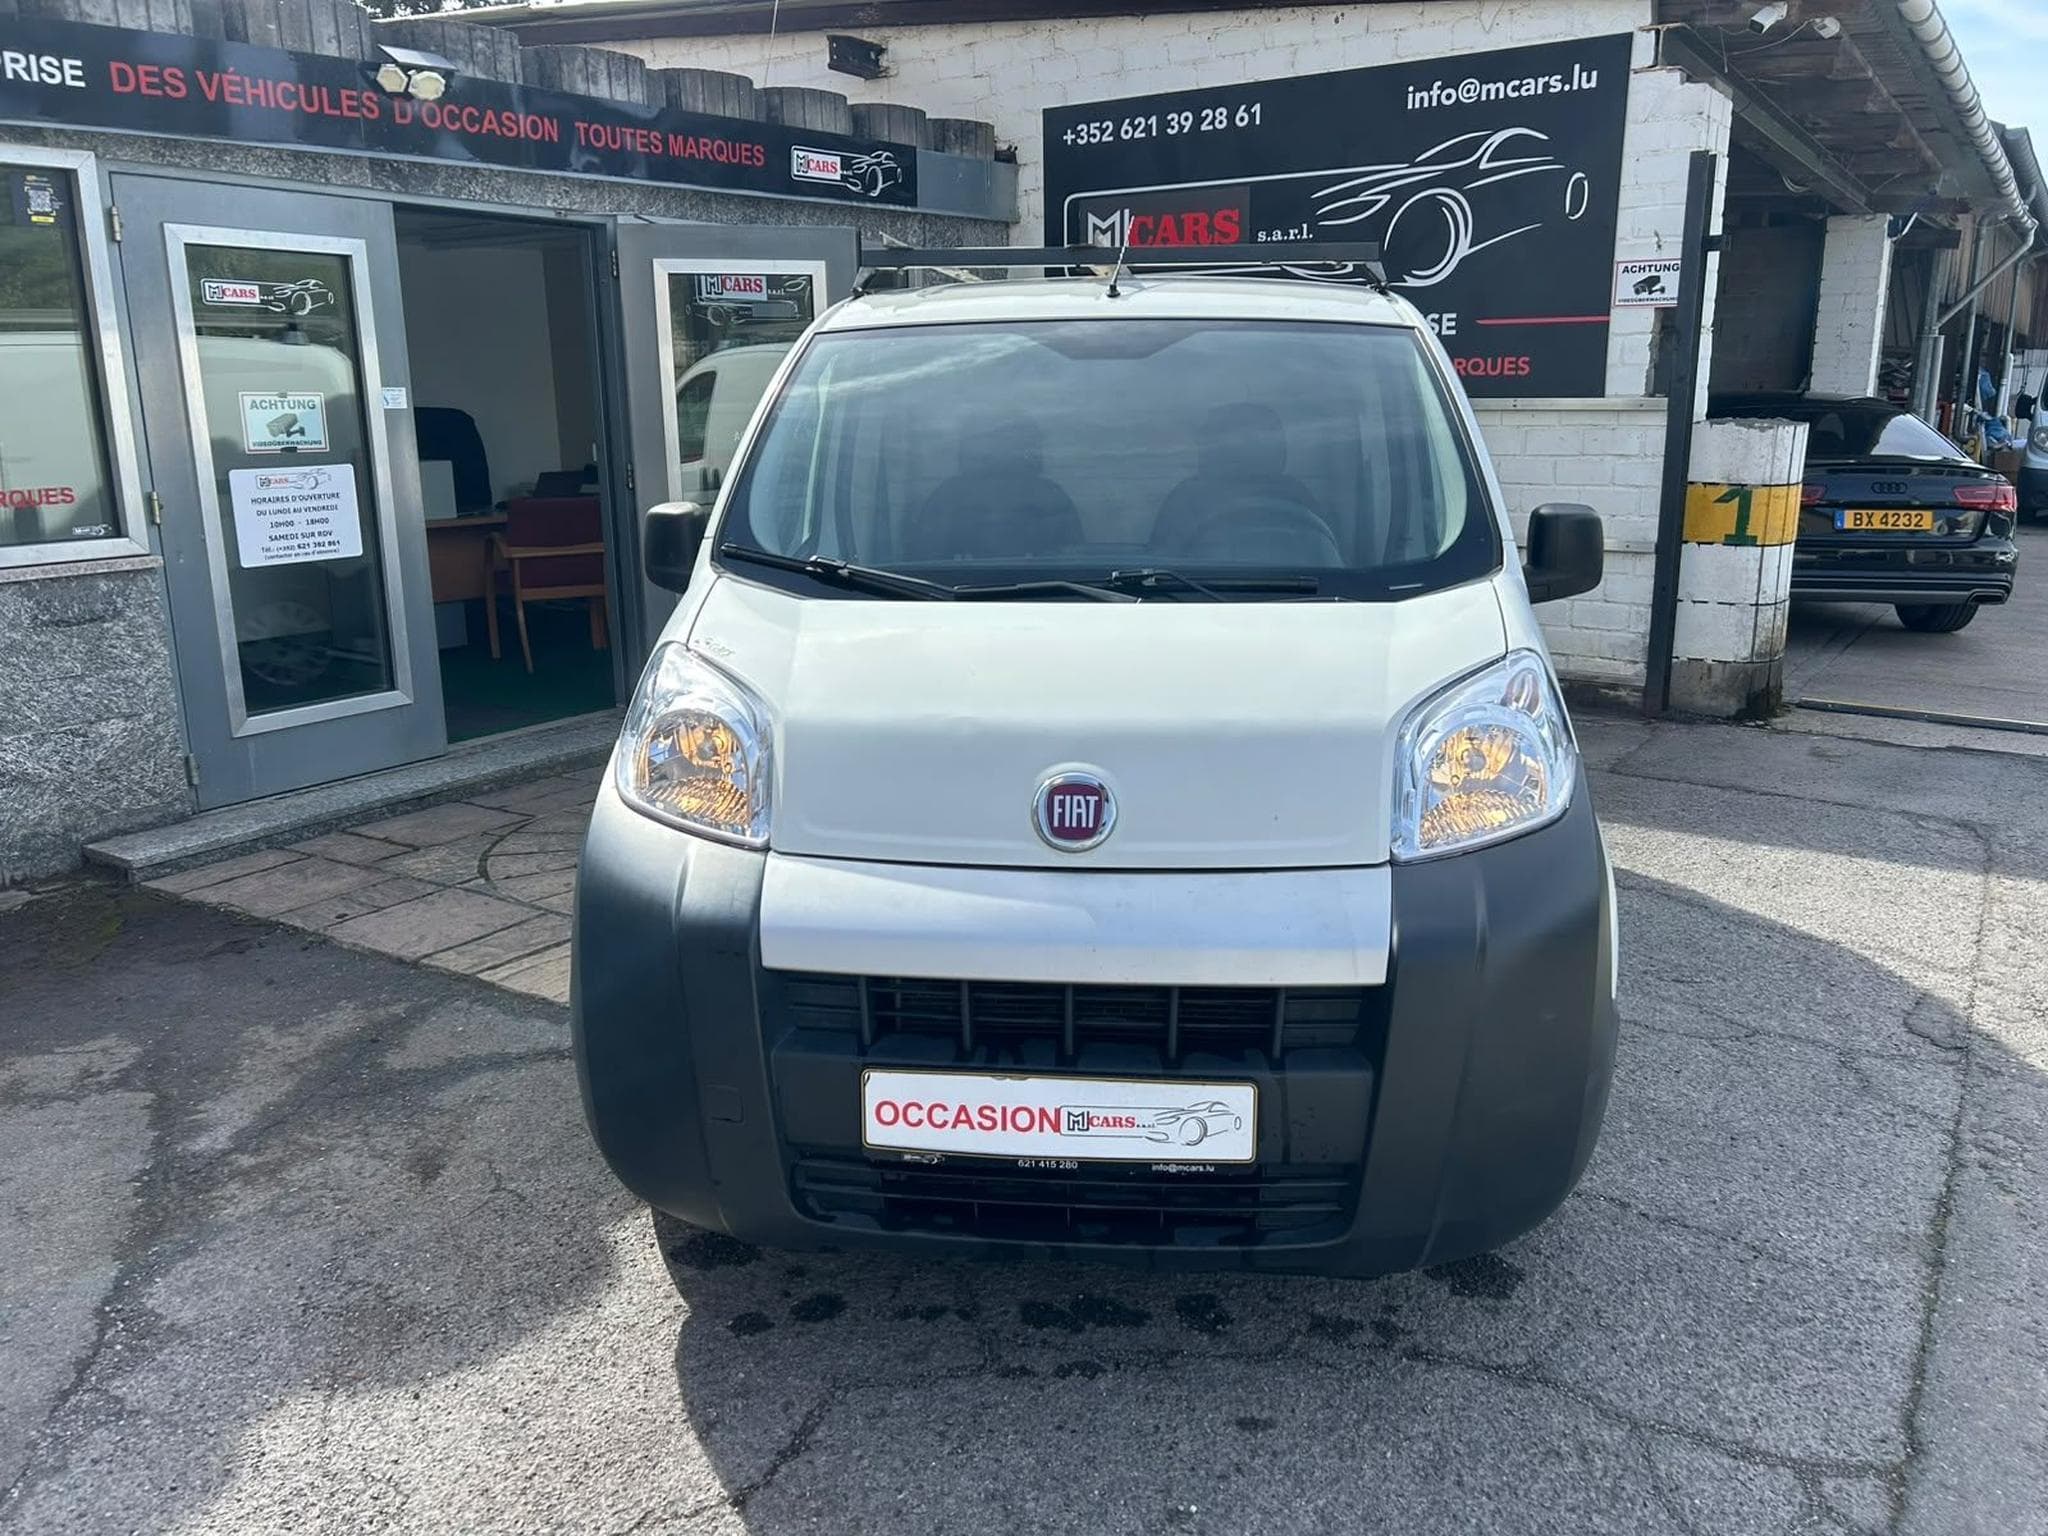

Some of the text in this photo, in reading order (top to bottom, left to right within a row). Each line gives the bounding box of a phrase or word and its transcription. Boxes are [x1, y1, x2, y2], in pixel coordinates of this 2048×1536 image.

[1407, 63, 1598, 109] info@mcars.lu
[0, 50, 86, 87] RISE
[108, 60, 188, 99] DES
[195, 67, 381, 119] VÉHICULES
[575, 121, 663, 155] TOUTES
[668, 133, 765, 167] MARQUES
[1063, 103, 1261, 145] +352 621 39 28 61
[1257, 223, 1313, 242] s.a.r.l.
[1622, 263, 1680, 274] ACHTUNG
[250, 398, 316, 410] ACHTUNG
[251, 495, 290, 504] HORAIRES
[1712, 487, 1759, 545] 1
[1853, 512, 1875, 527] BX
[1879, 512, 1924, 527] 4232
[300, 531, 316, 539] SUR
[1053, 795, 1099, 828] FIAT
[875, 1099, 1061, 1134] OCCASION
[1018, 1160, 1035, 1168] 621
